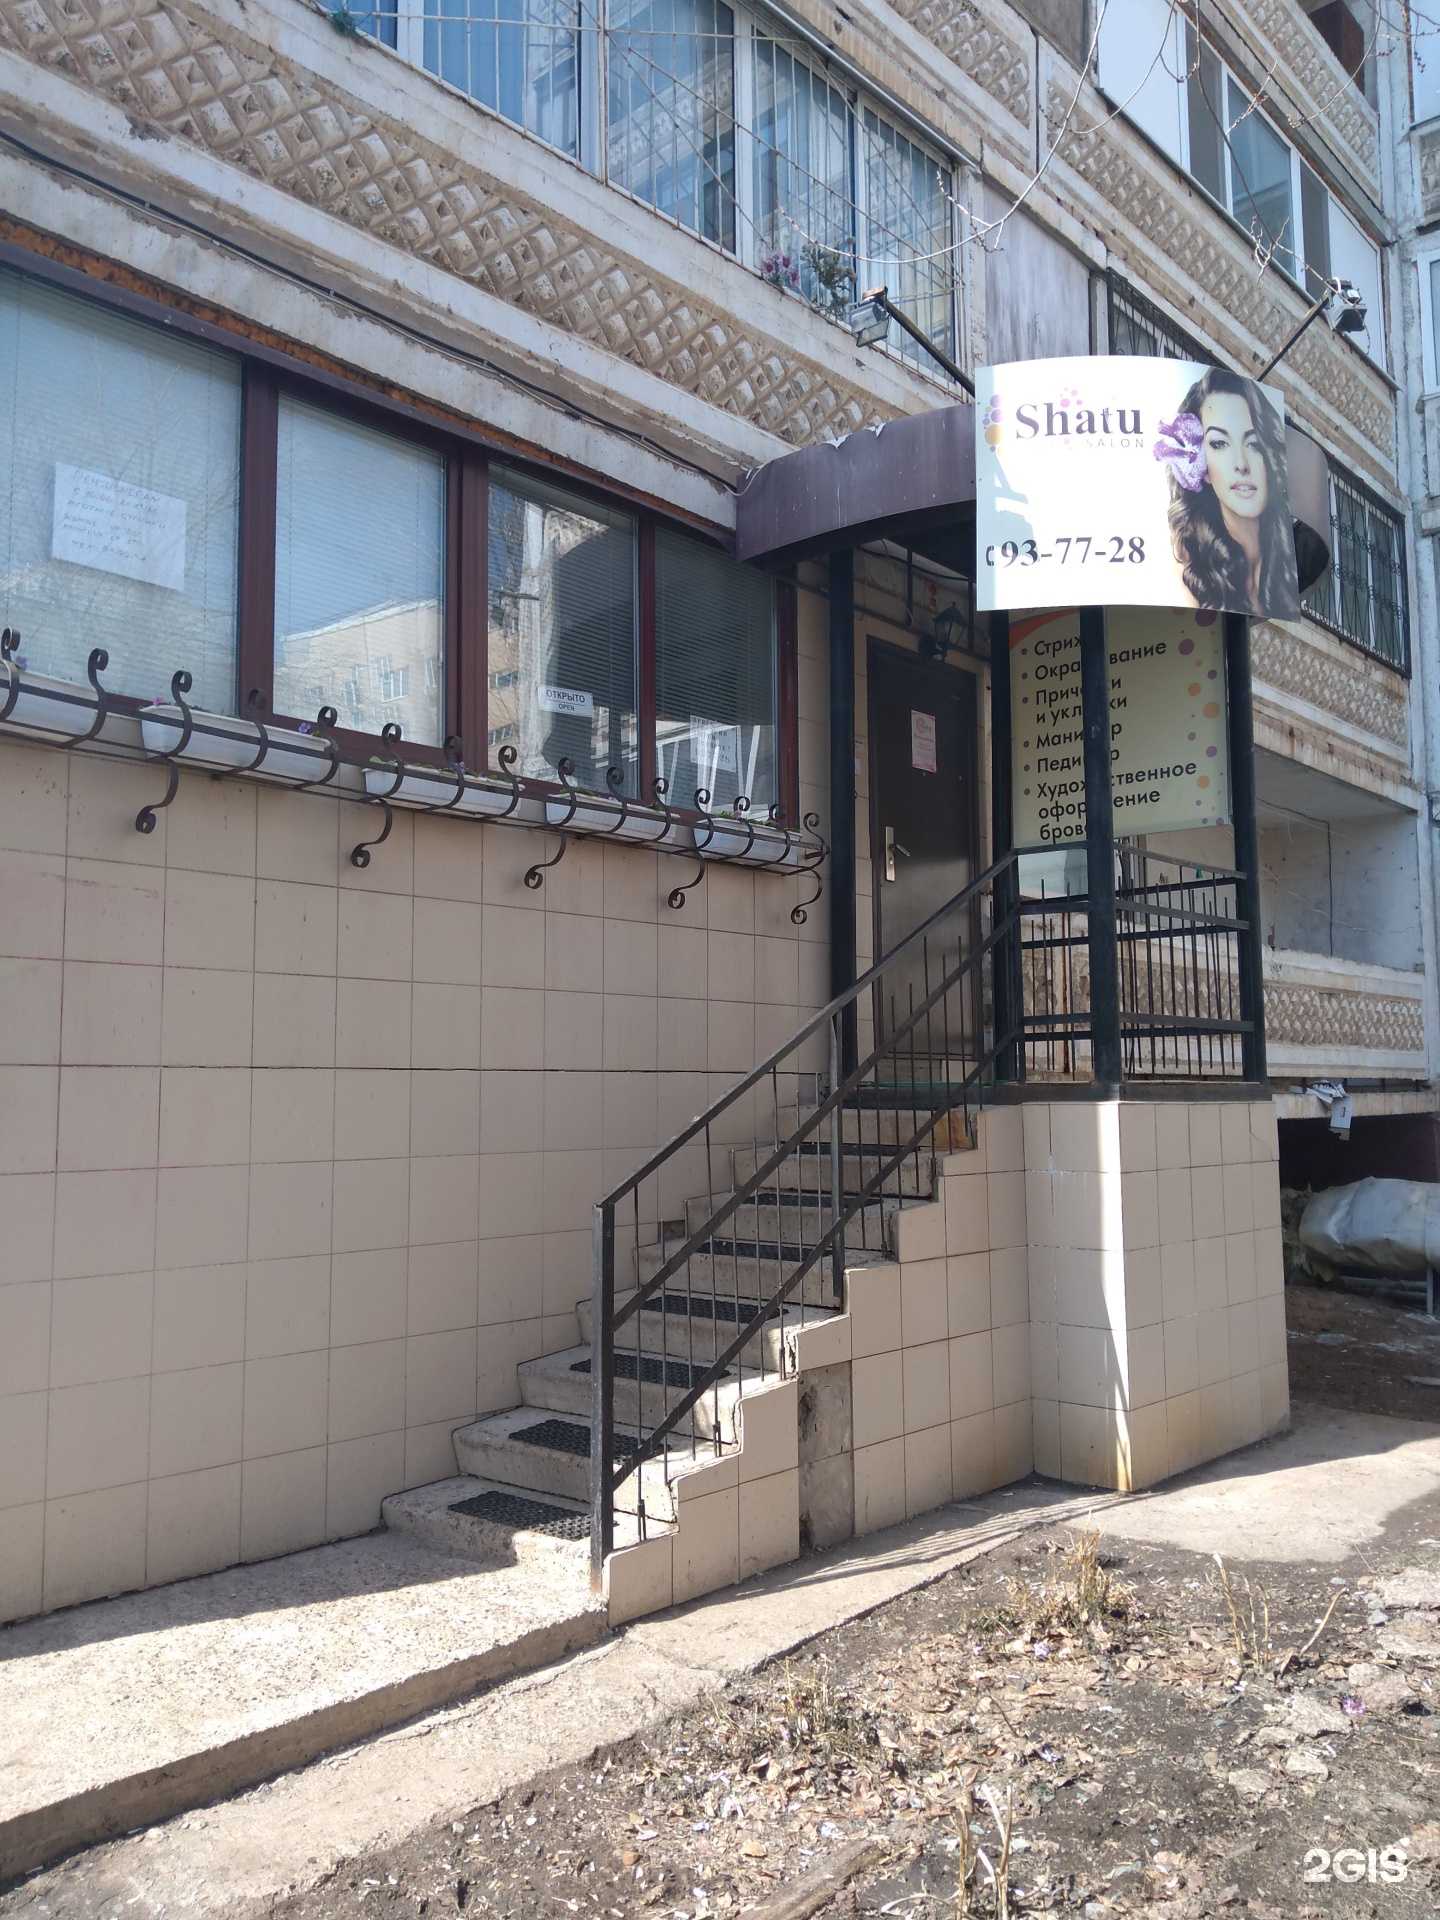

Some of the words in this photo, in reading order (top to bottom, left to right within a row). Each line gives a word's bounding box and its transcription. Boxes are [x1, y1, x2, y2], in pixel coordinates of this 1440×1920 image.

[1015, 402, 1143, 441] Shatu
[1086, 437, 1144, 449] SALON
[1001, 536, 1145, 567] 93-77-28
[1035, 641, 1167, 681] Окравание
[545, 689, 586, 703] ОТКРЫТО
[1036, 712, 1046, 725] и
[1038, 789, 1161, 822] офорение
